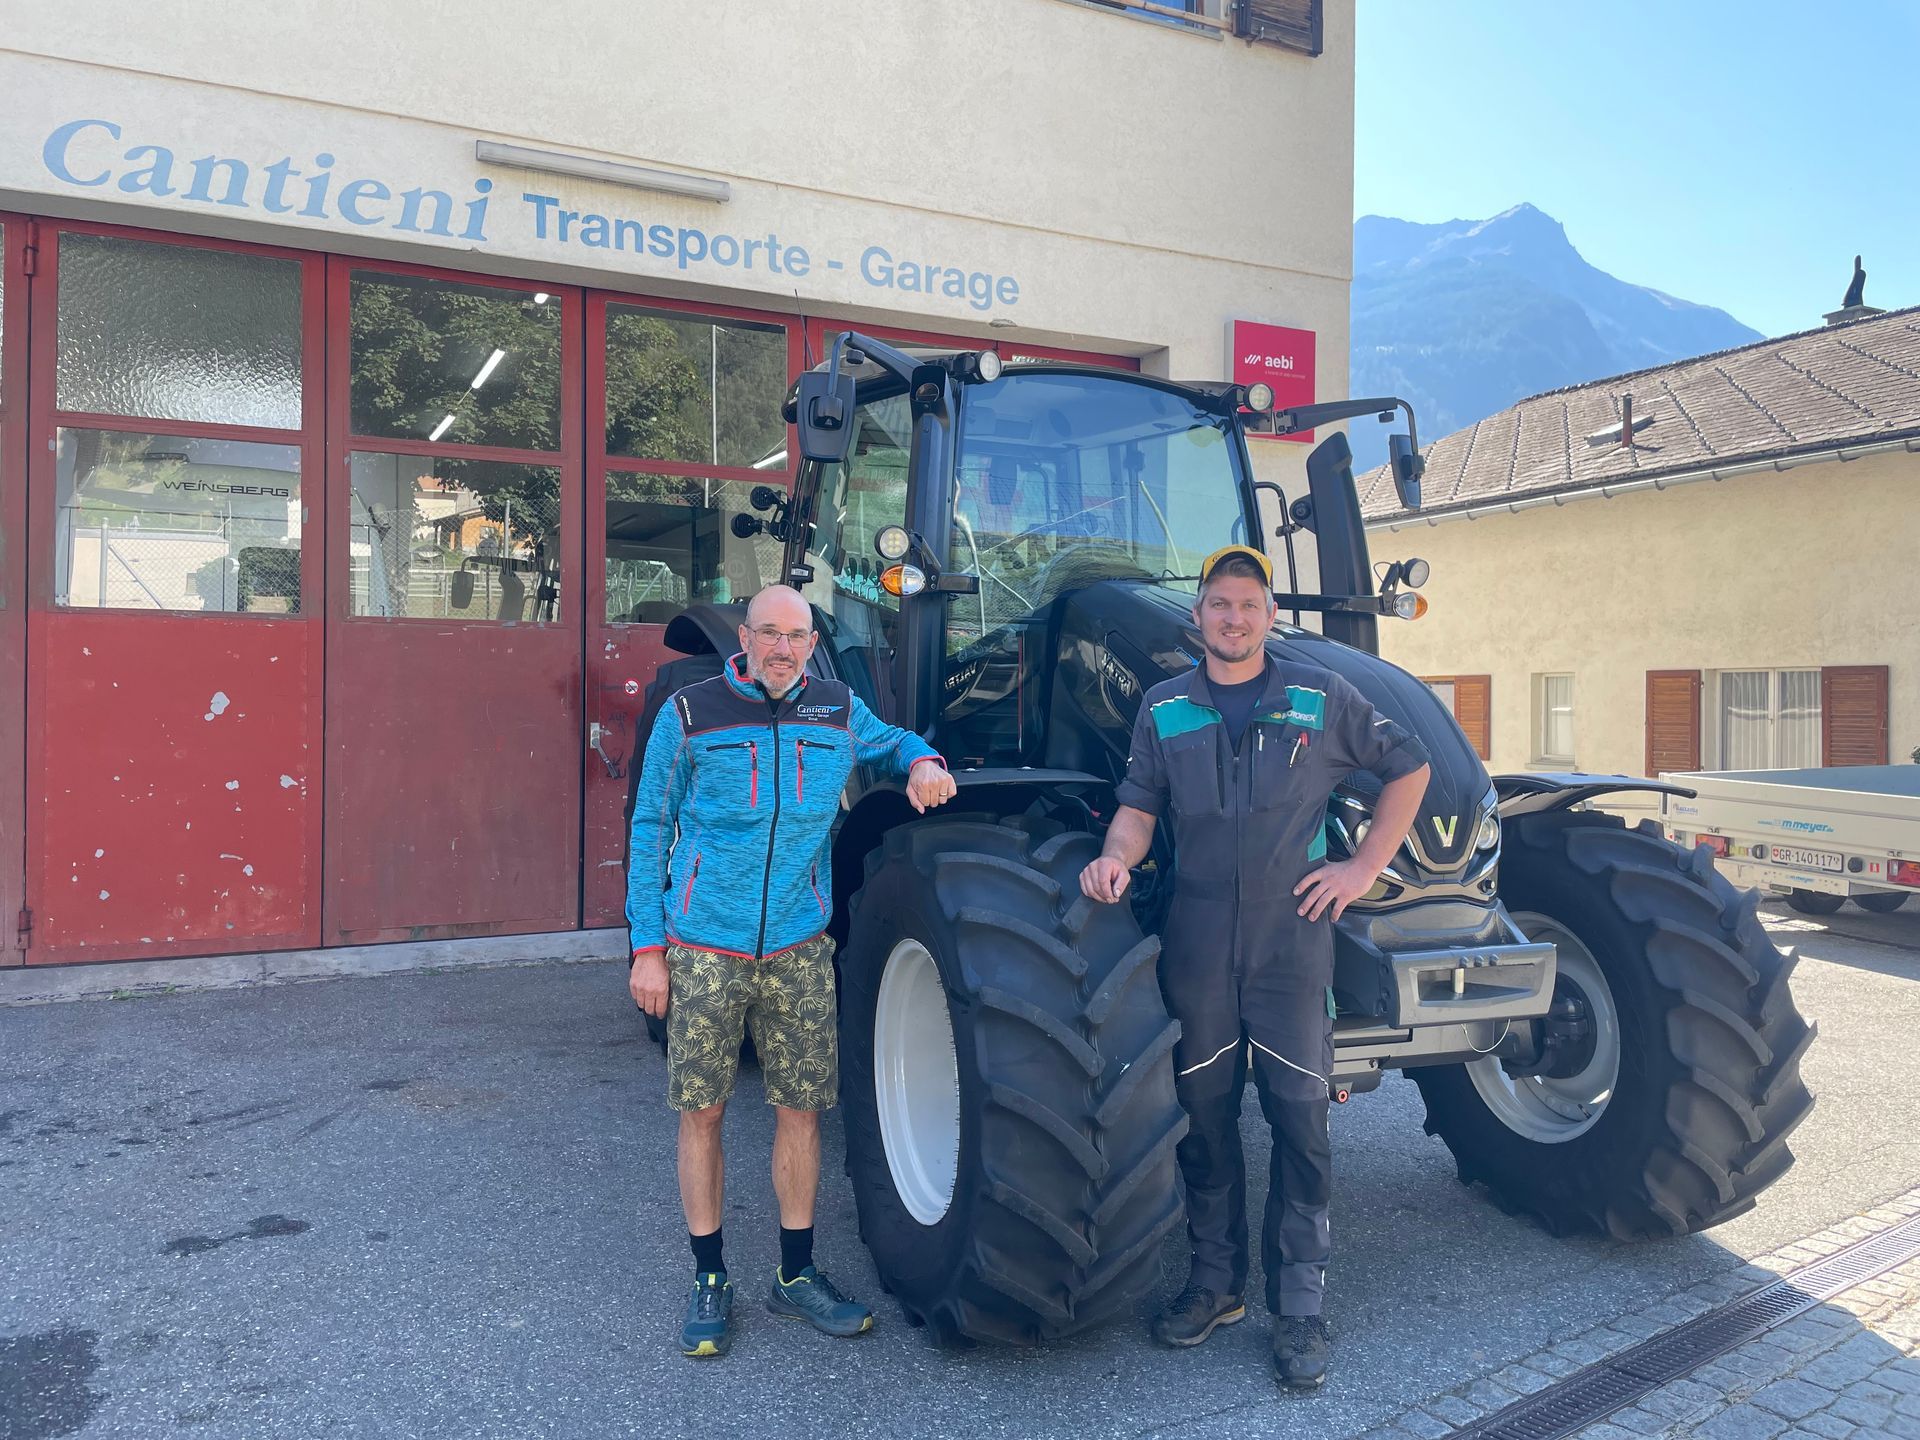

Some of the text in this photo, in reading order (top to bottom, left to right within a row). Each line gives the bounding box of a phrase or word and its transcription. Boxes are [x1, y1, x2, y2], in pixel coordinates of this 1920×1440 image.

[43, 119, 494, 242] Cantieni
[523, 193, 811, 276] Transporte
[860, 245, 1020, 311] Garage
[1264, 354, 1294, 370] aebi
[1432, 815, 1458, 848] V
